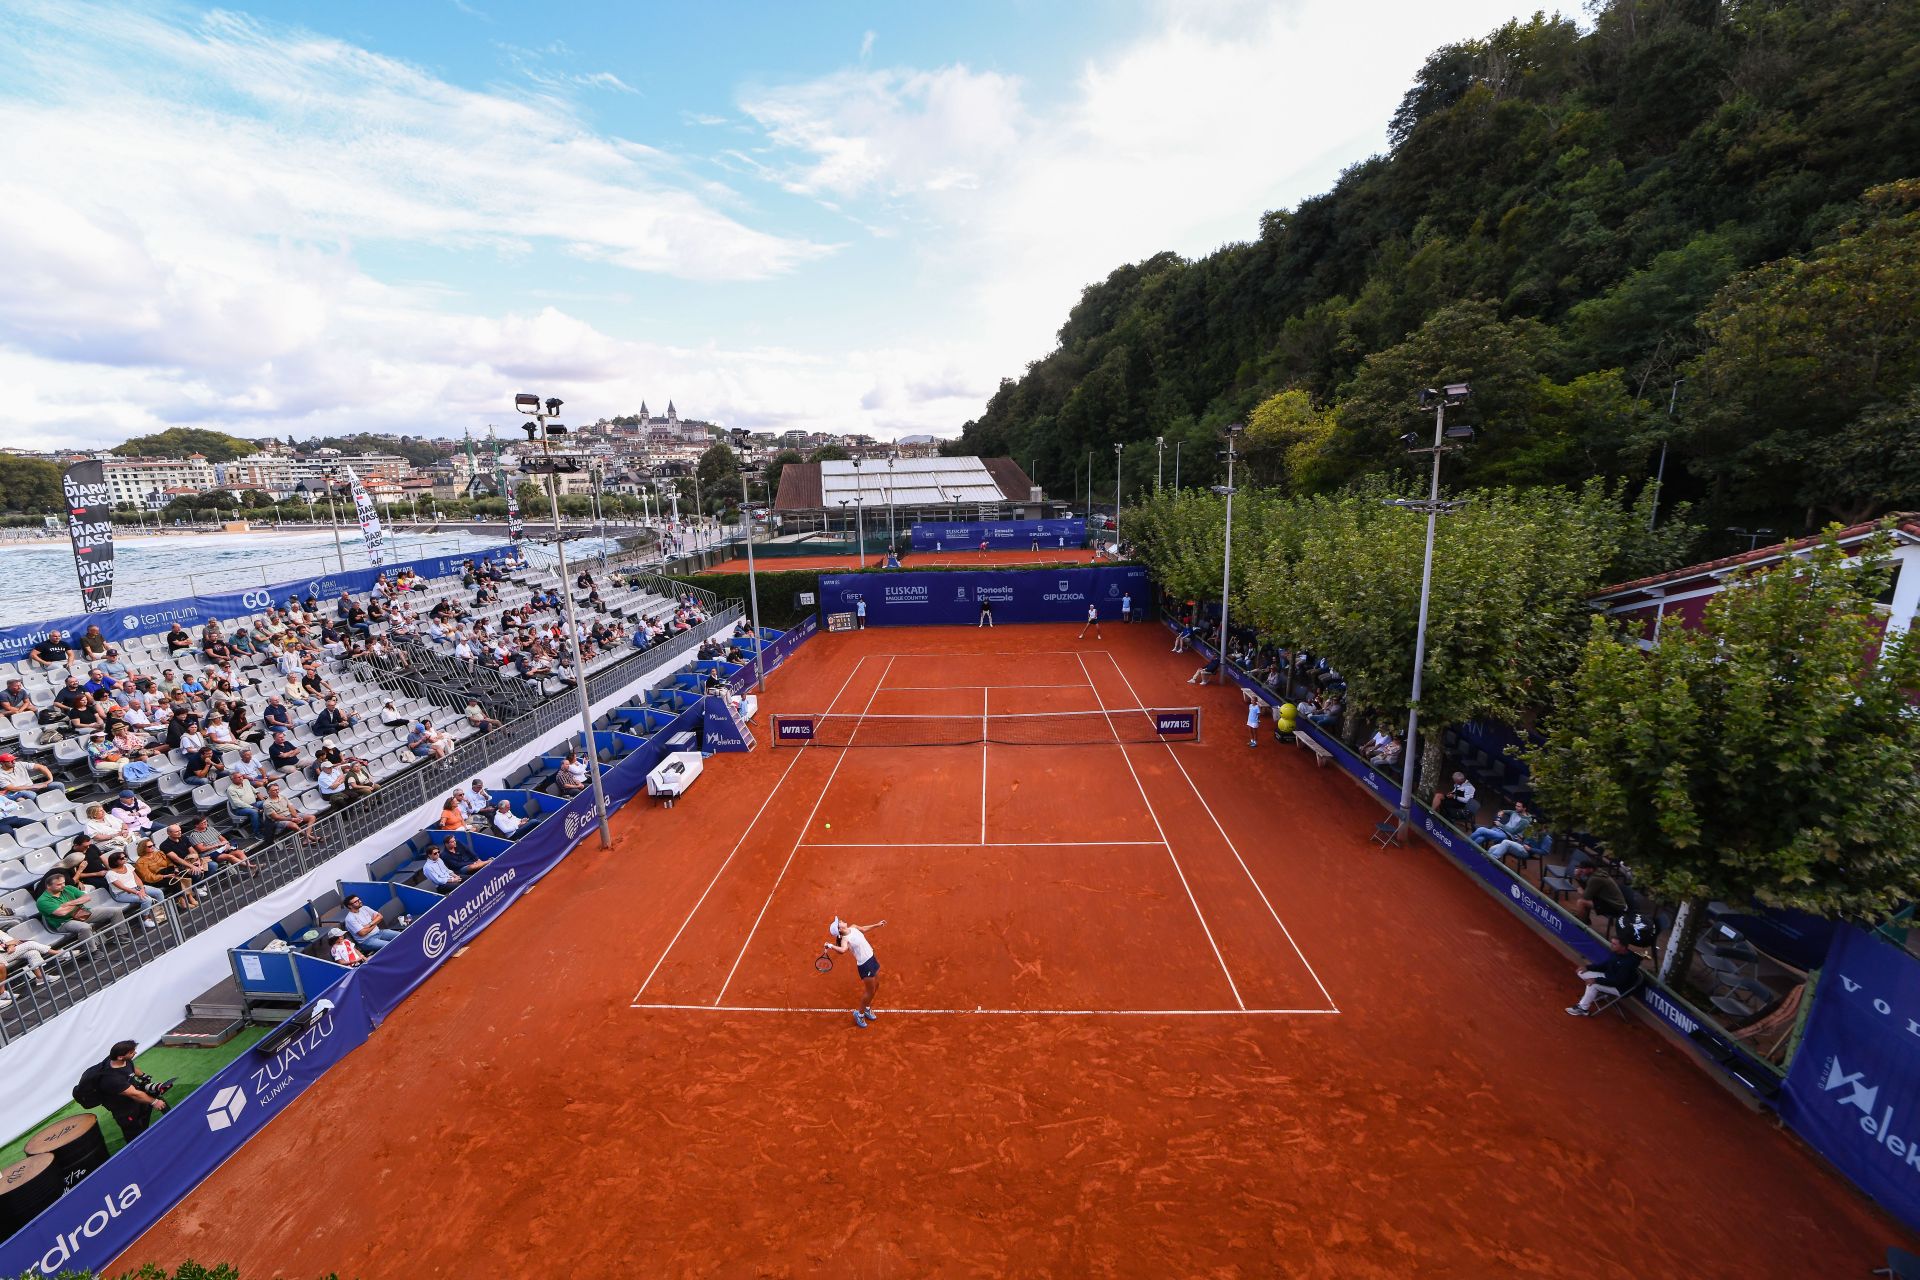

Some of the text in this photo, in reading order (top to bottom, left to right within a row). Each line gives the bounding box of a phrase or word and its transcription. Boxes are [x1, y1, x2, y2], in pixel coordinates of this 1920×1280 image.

[65, 482, 107, 498] DIARI
[71, 521, 112, 537] DIARI
[885, 586, 928, 595] EUSKADI
[976, 586, 1013, 594] Donostia
[140, 606, 198, 625] tennium
[717, 735, 741, 746] elektra
[580, 795, 611, 827] ceia
[1432, 828, 1452, 847] ceinsa
[447, 867, 516, 931] Naturklima
[1520, 890, 1562, 931] tennium
[250, 1014, 334, 1095] ZUATZU
[260, 1075, 294, 1107] KLINIKA
